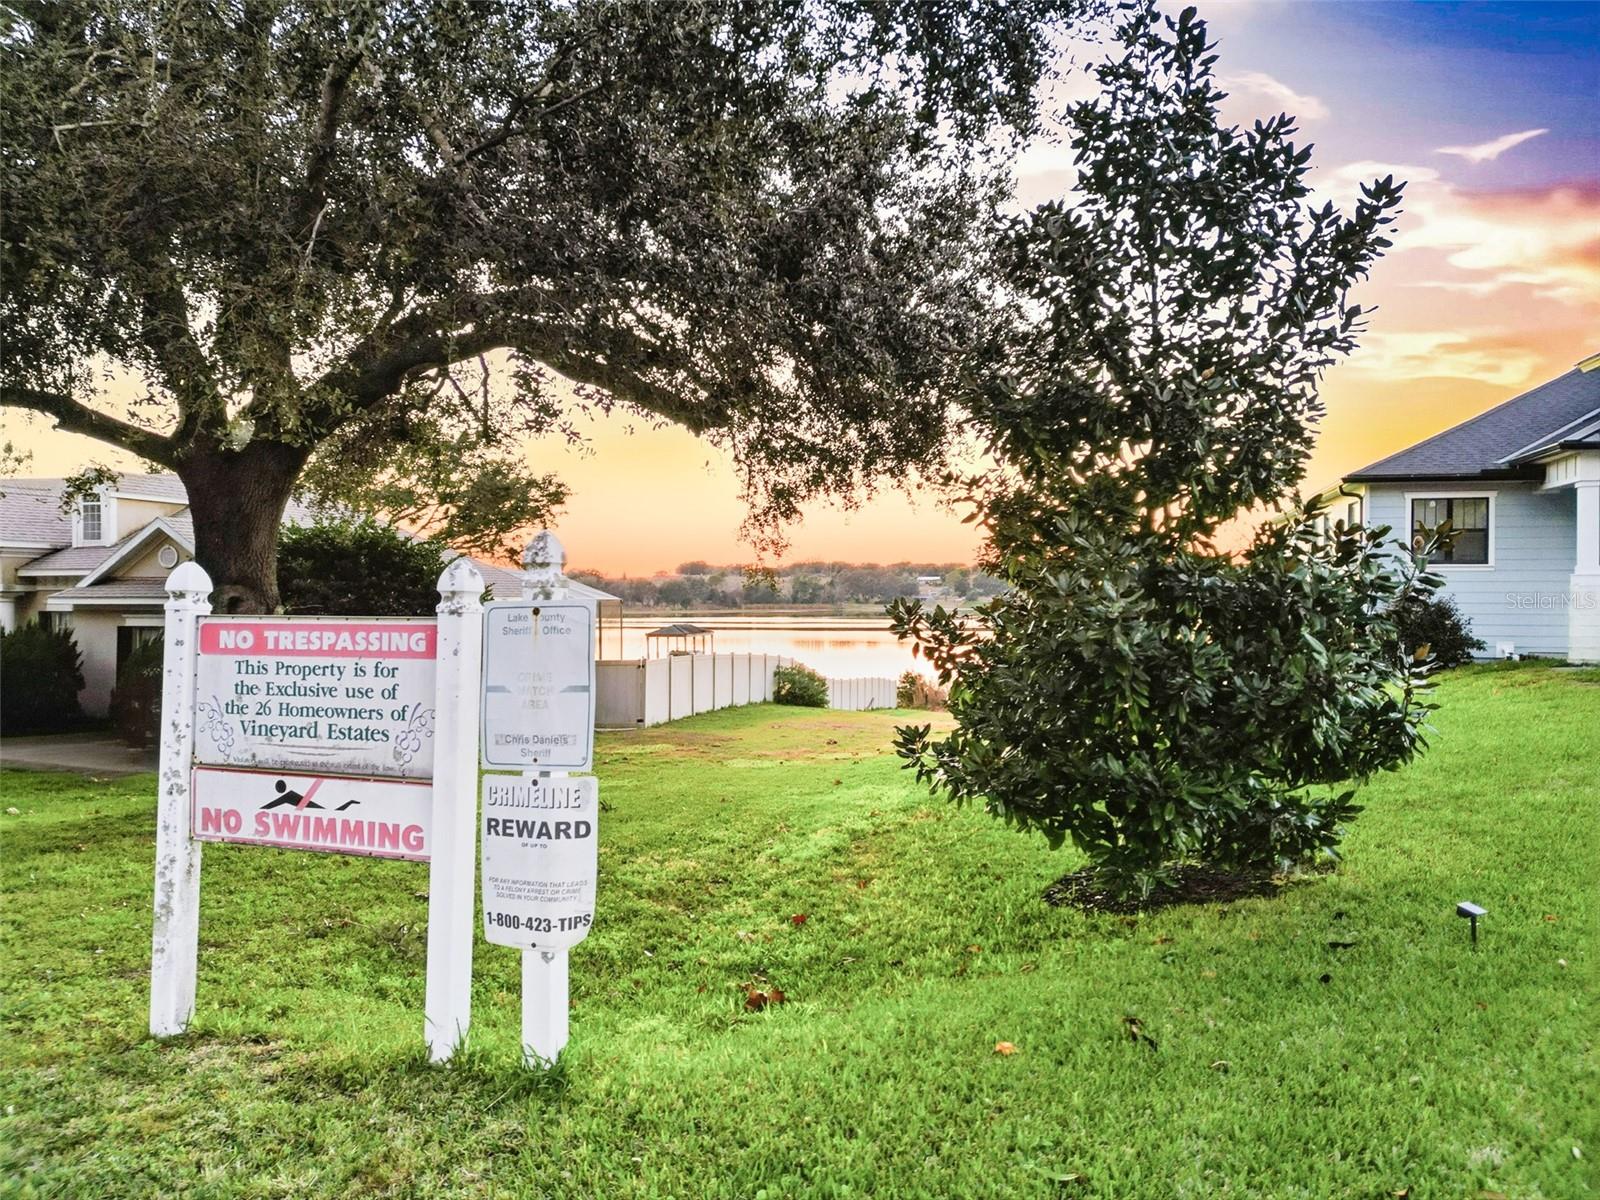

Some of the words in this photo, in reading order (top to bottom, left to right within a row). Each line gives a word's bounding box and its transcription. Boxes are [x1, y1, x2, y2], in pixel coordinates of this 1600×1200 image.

[507, 613, 528, 623] Lake
[531, 613, 566, 624] ounty
[219, 630, 254, 649] NO
[264, 631, 426, 652] TRESPASSING
[542, 626, 572, 636] Office
[234, 660, 268, 675] This
[275, 661, 345, 681] Property
[354, 662, 366, 677] is
[374, 662, 399, 678] for
[234, 681, 258, 696] the
[265, 681, 338, 698] Exclusive
[345, 688, 374, 699] use
[381, 684, 399, 699] of
[225, 700, 249, 715] the
[255, 700, 271, 716] 26
[278, 703, 383, 720] Homeowners
[391, 705, 409, 721] of
[240, 720, 318, 742] Vineyard
[328, 724, 390, 743] Estates
[505, 734, 530, 744] Chris
[520, 748, 551, 758] Sheriff
[487, 786, 582, 809] CRIMELINE
[201, 808, 243, 834] NO
[255, 811, 424, 852] SWIMMING
[486, 818, 592, 840] REWARD
[549, 880, 565, 888] THAT
[567, 880, 588, 888] LEADS
[486, 911, 592, 933] 1-800-423-TIPS
